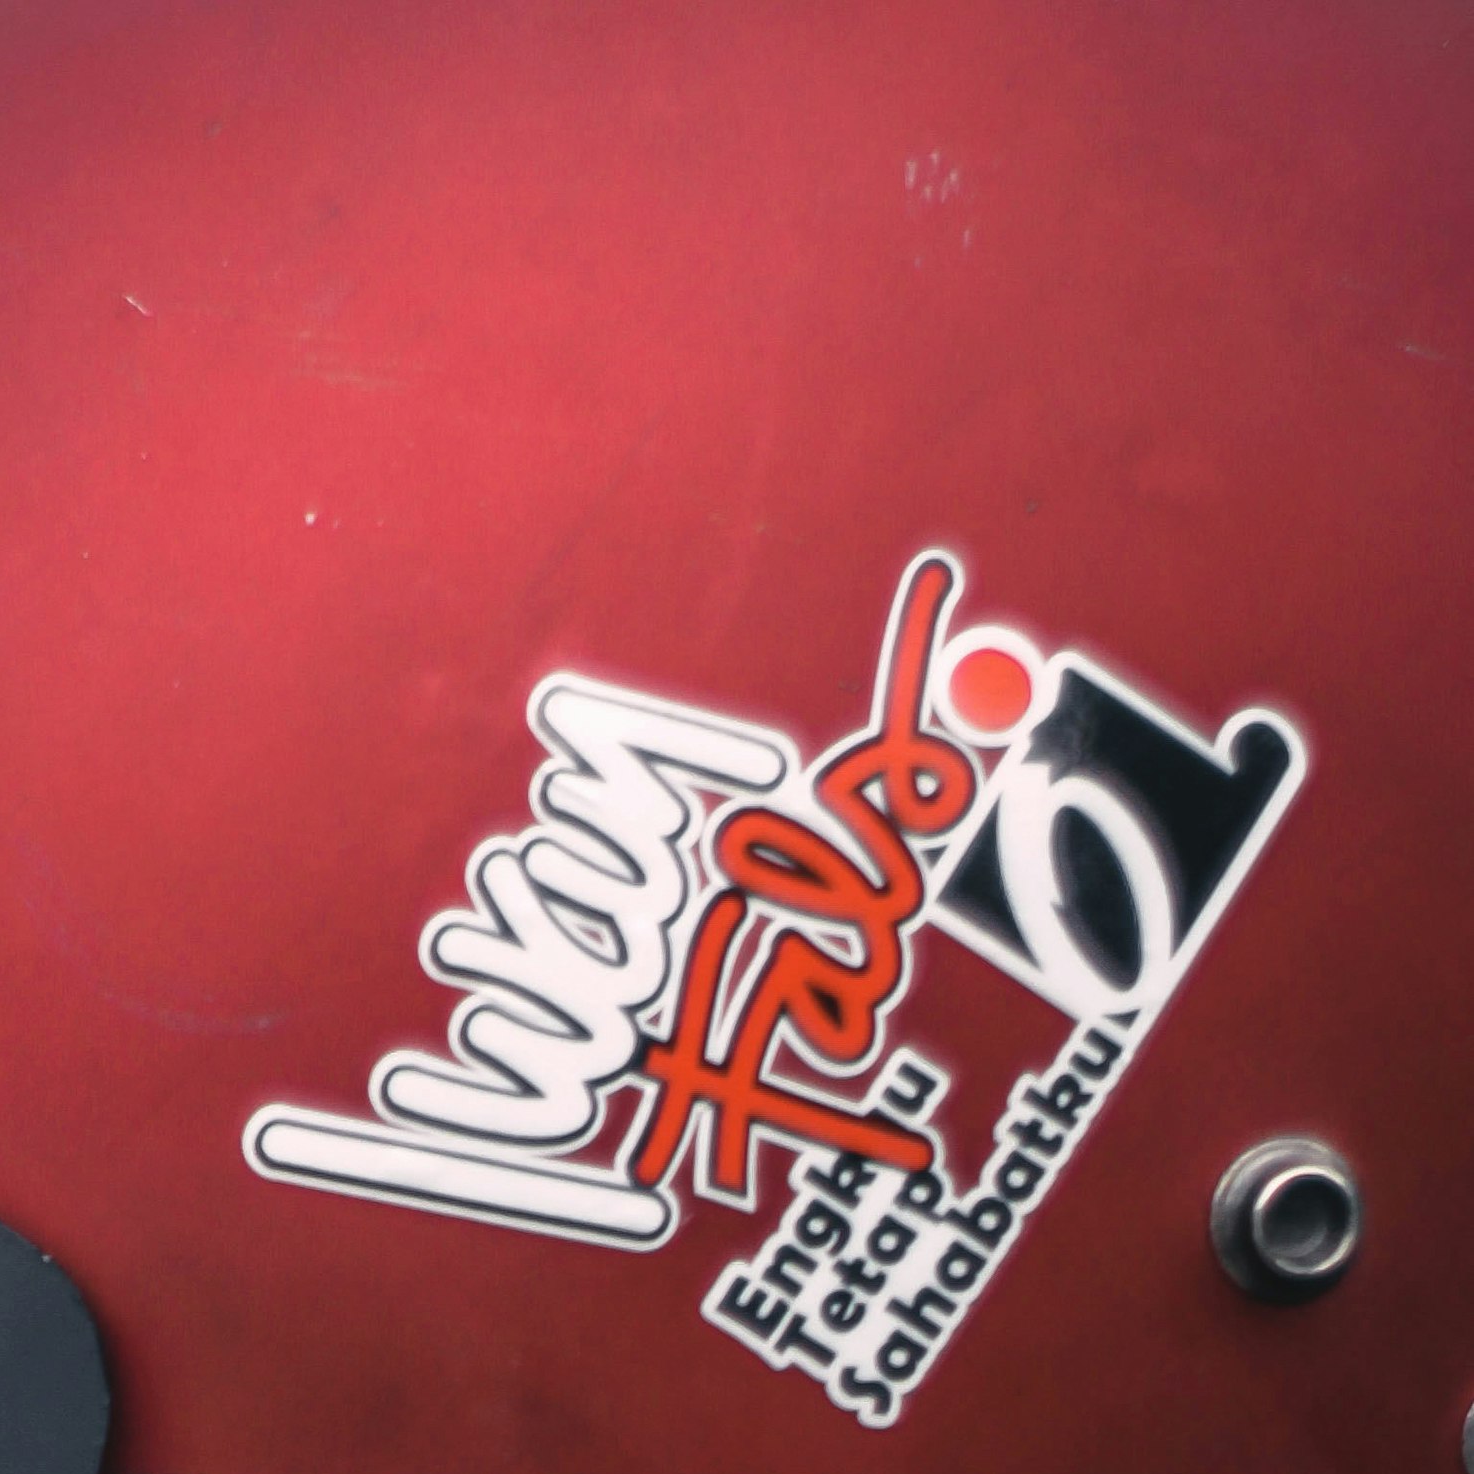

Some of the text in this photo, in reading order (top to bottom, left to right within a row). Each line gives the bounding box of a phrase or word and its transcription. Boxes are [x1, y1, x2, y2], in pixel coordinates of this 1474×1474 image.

[252, 684, 788, 1242] Iwan
[633, 558, 976, 1191] Fals
[717, 1062, 938, 1342] Engku
[774, 1166, 947, 1367] Tetap
[839, 1027, 1123, 1416] Sahabatku
